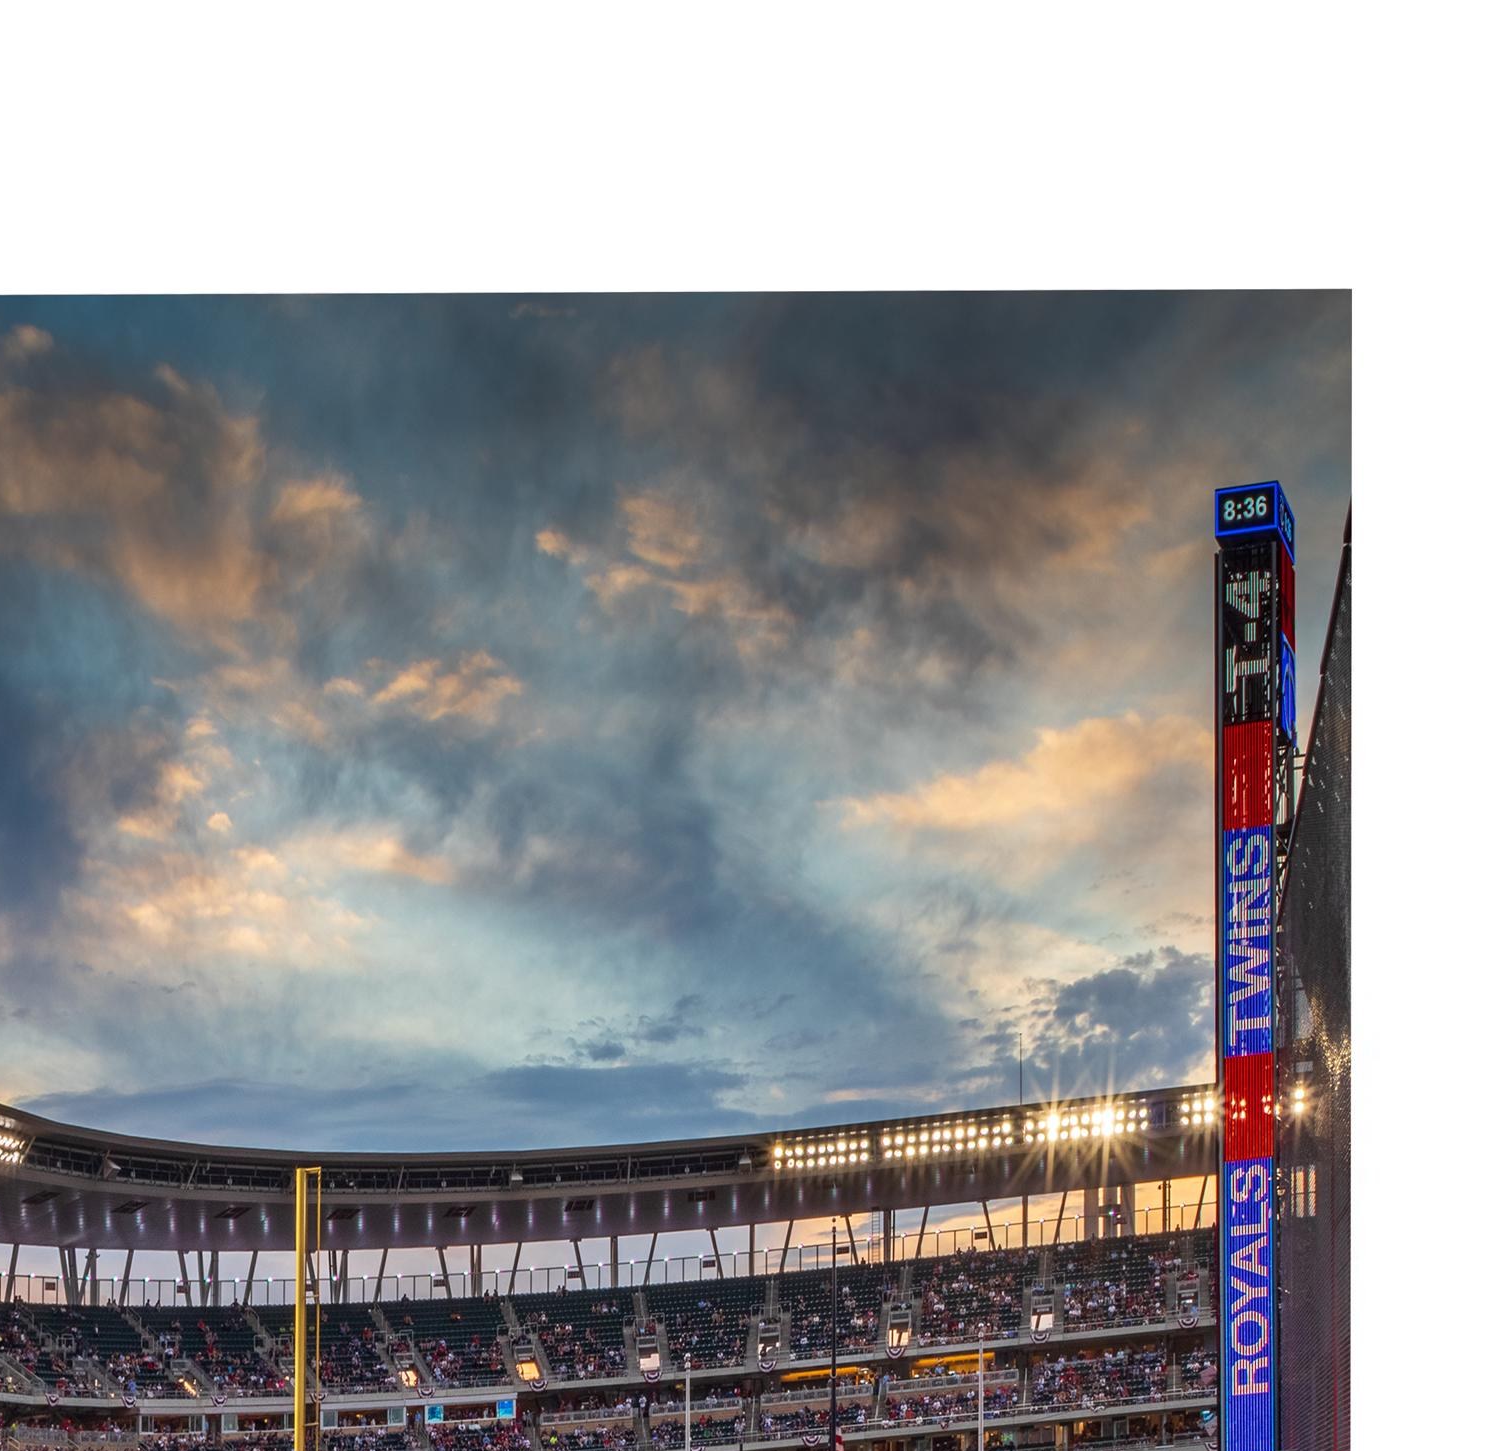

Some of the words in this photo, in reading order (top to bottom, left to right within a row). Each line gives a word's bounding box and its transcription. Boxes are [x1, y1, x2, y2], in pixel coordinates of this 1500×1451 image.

[1223, 495, 1268, 522] 8:36
[1226, 834, 1271, 1047] TWINS
[1231, 1164, 1268, 1396] ROYALS
